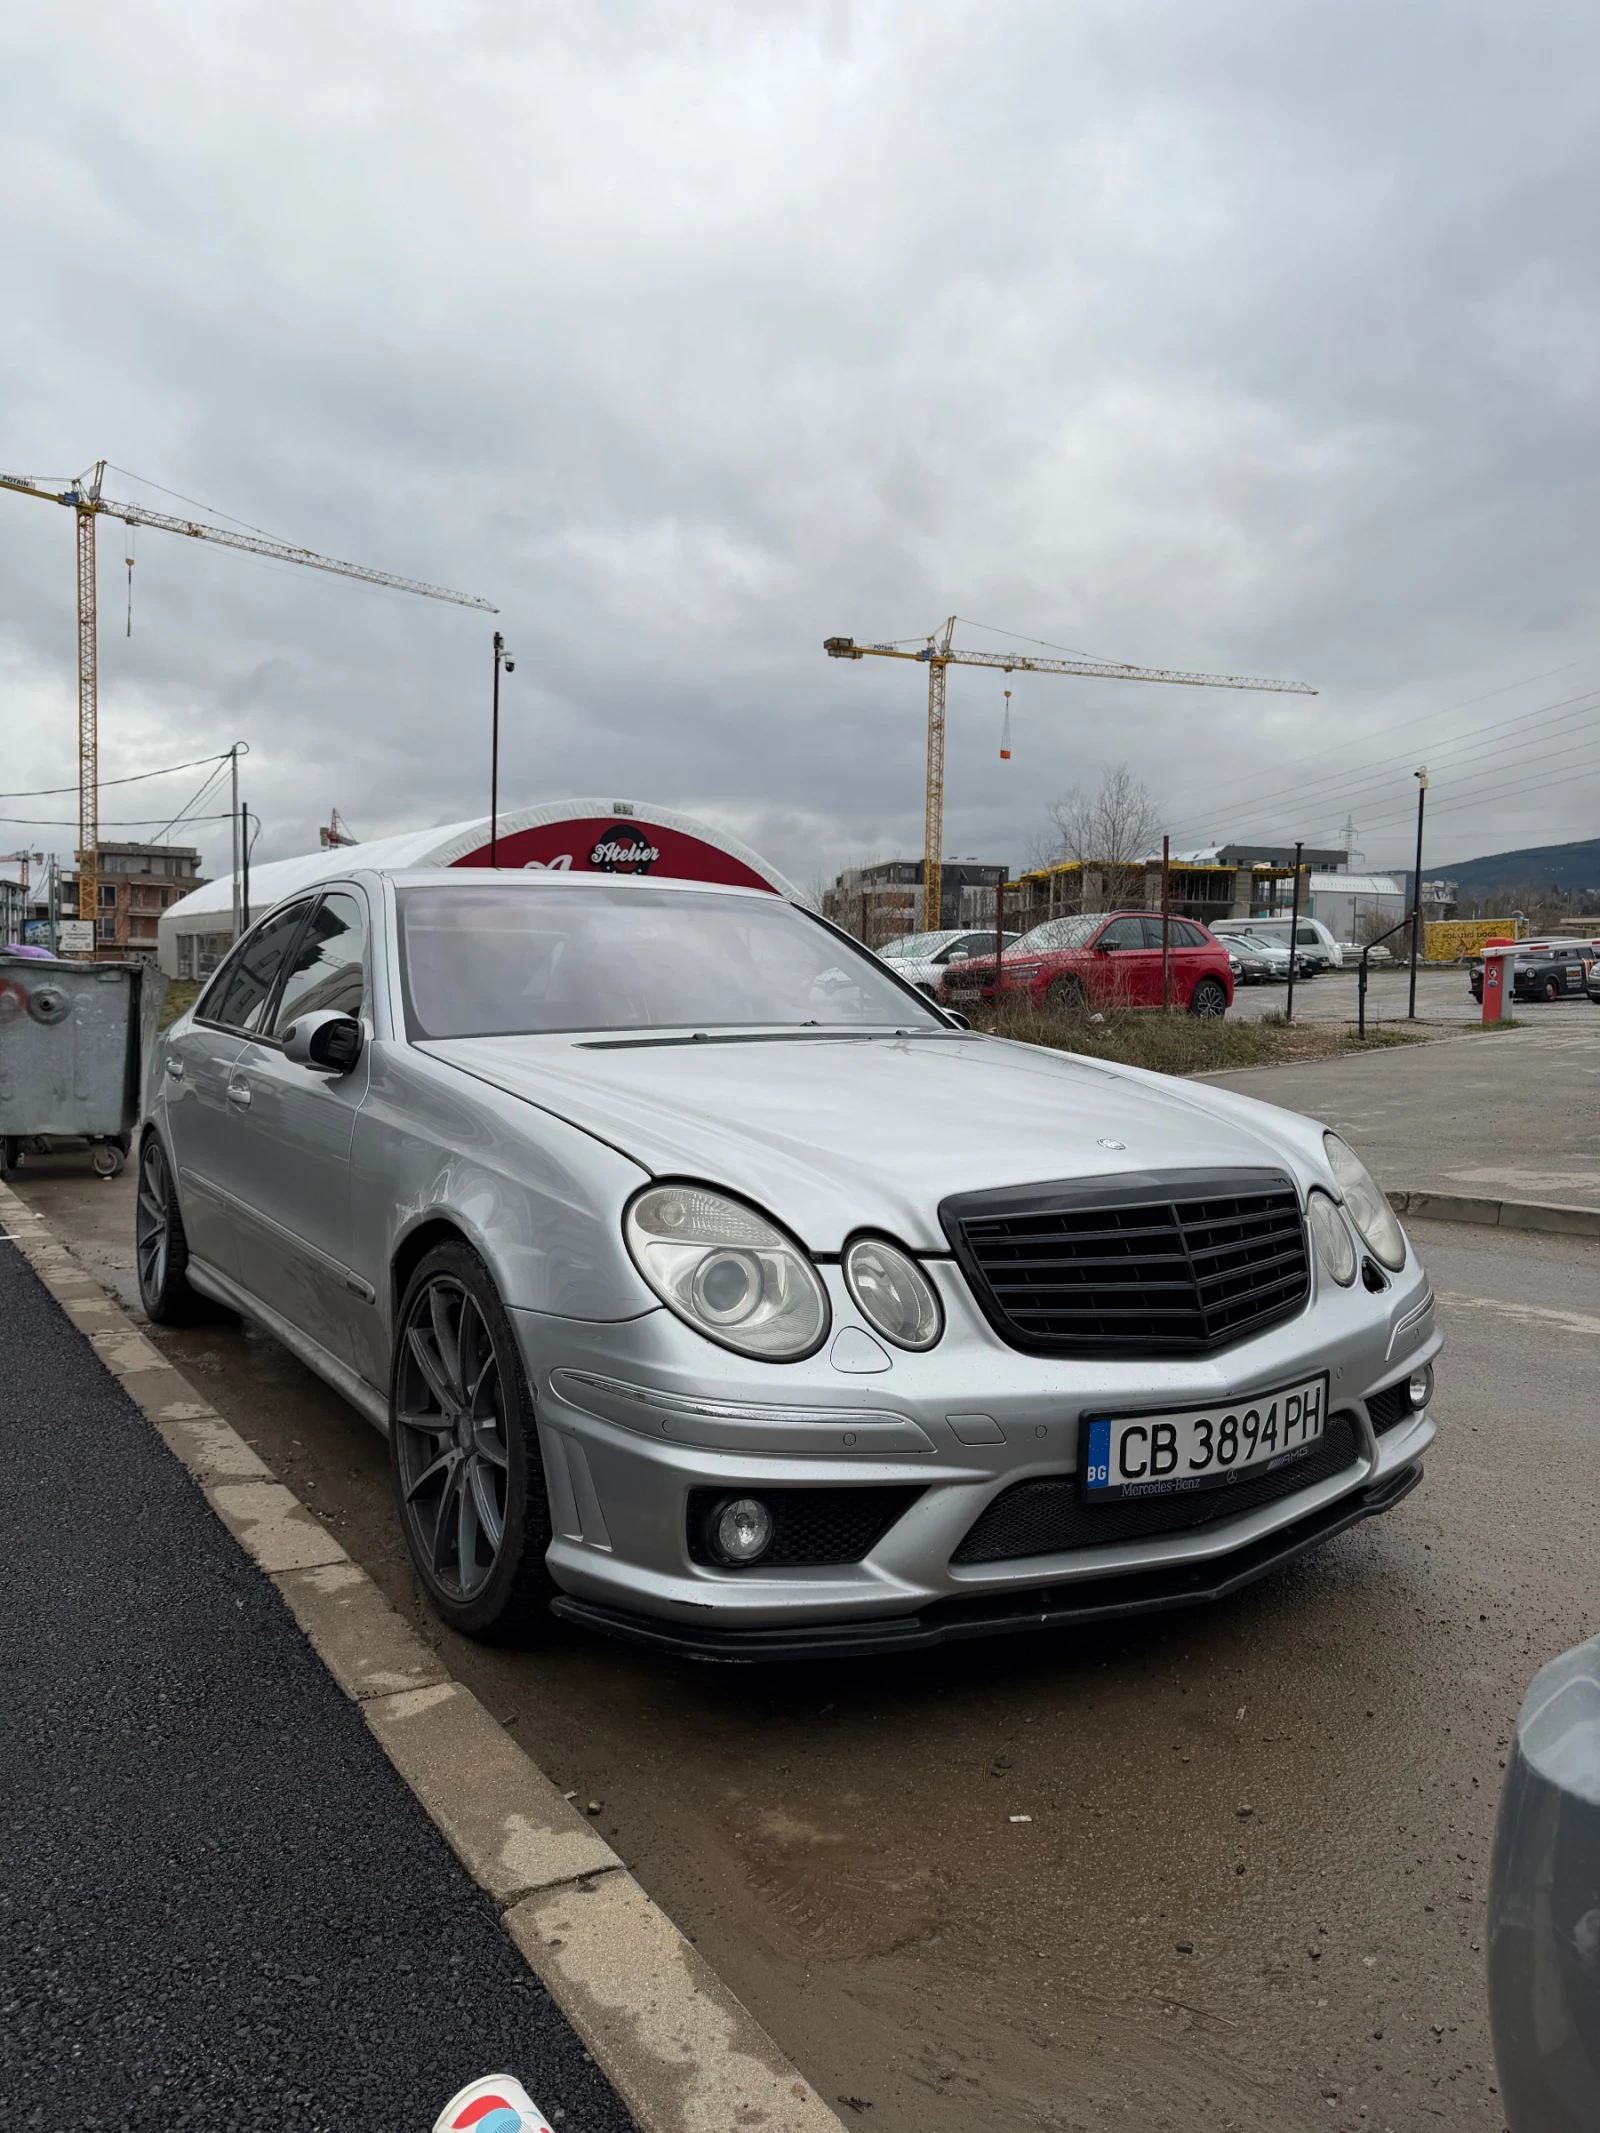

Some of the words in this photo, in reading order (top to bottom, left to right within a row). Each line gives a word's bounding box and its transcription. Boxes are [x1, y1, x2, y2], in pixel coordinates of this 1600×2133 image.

[2, 475, 29, 487] POTAIN
[591, 841, 659, 863] Atelier
[1118, 1423, 1178, 1479] CB
[1189, 1401, 1278, 1470] 3894
[1284, 1386, 1321, 1447] PH
[1087, 1465, 1107, 1482] BG
[1121, 1477, 1201, 1497] Mercedes-Benz
[1280, 1445, 1308, 1465] AMG
